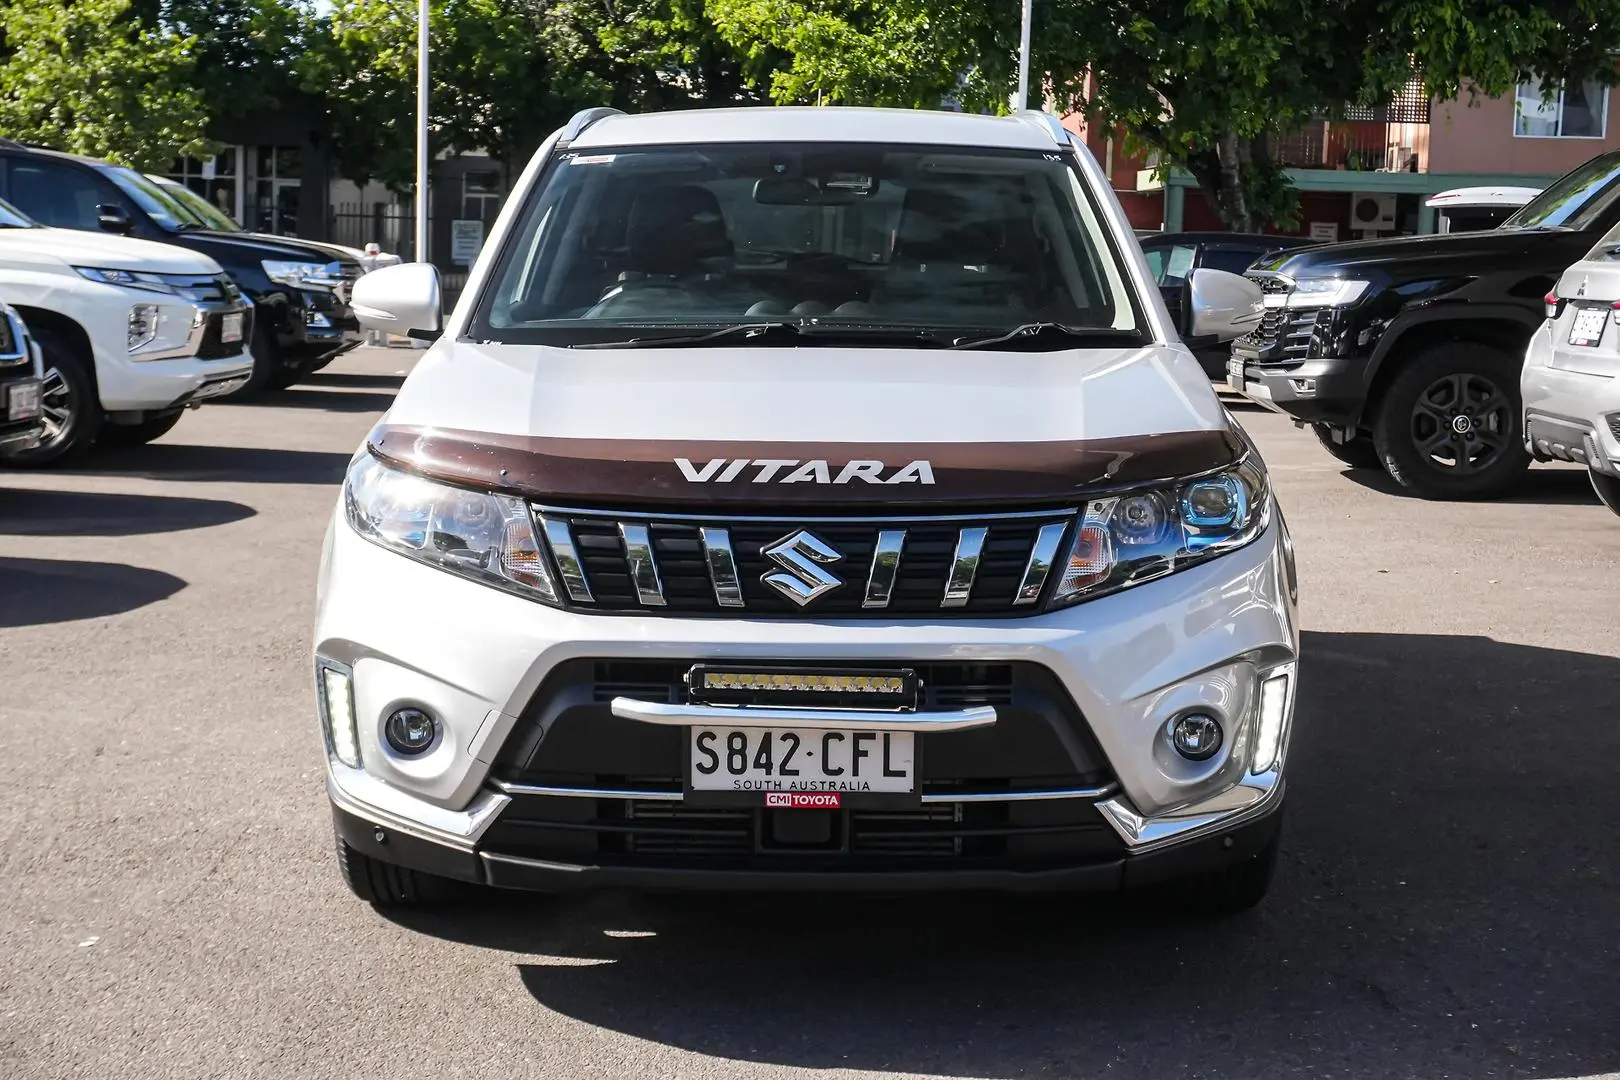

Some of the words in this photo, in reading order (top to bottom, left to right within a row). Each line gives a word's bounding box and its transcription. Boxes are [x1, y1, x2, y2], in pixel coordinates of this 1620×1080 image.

[673, 458, 936, 485] VITARA
[733, 780, 782, 790] SOUTH
[789, 781, 871, 791] AUSTRALIA
[768, 795, 791, 805] CMI
[792, 795, 838, 805] TOYOTA
